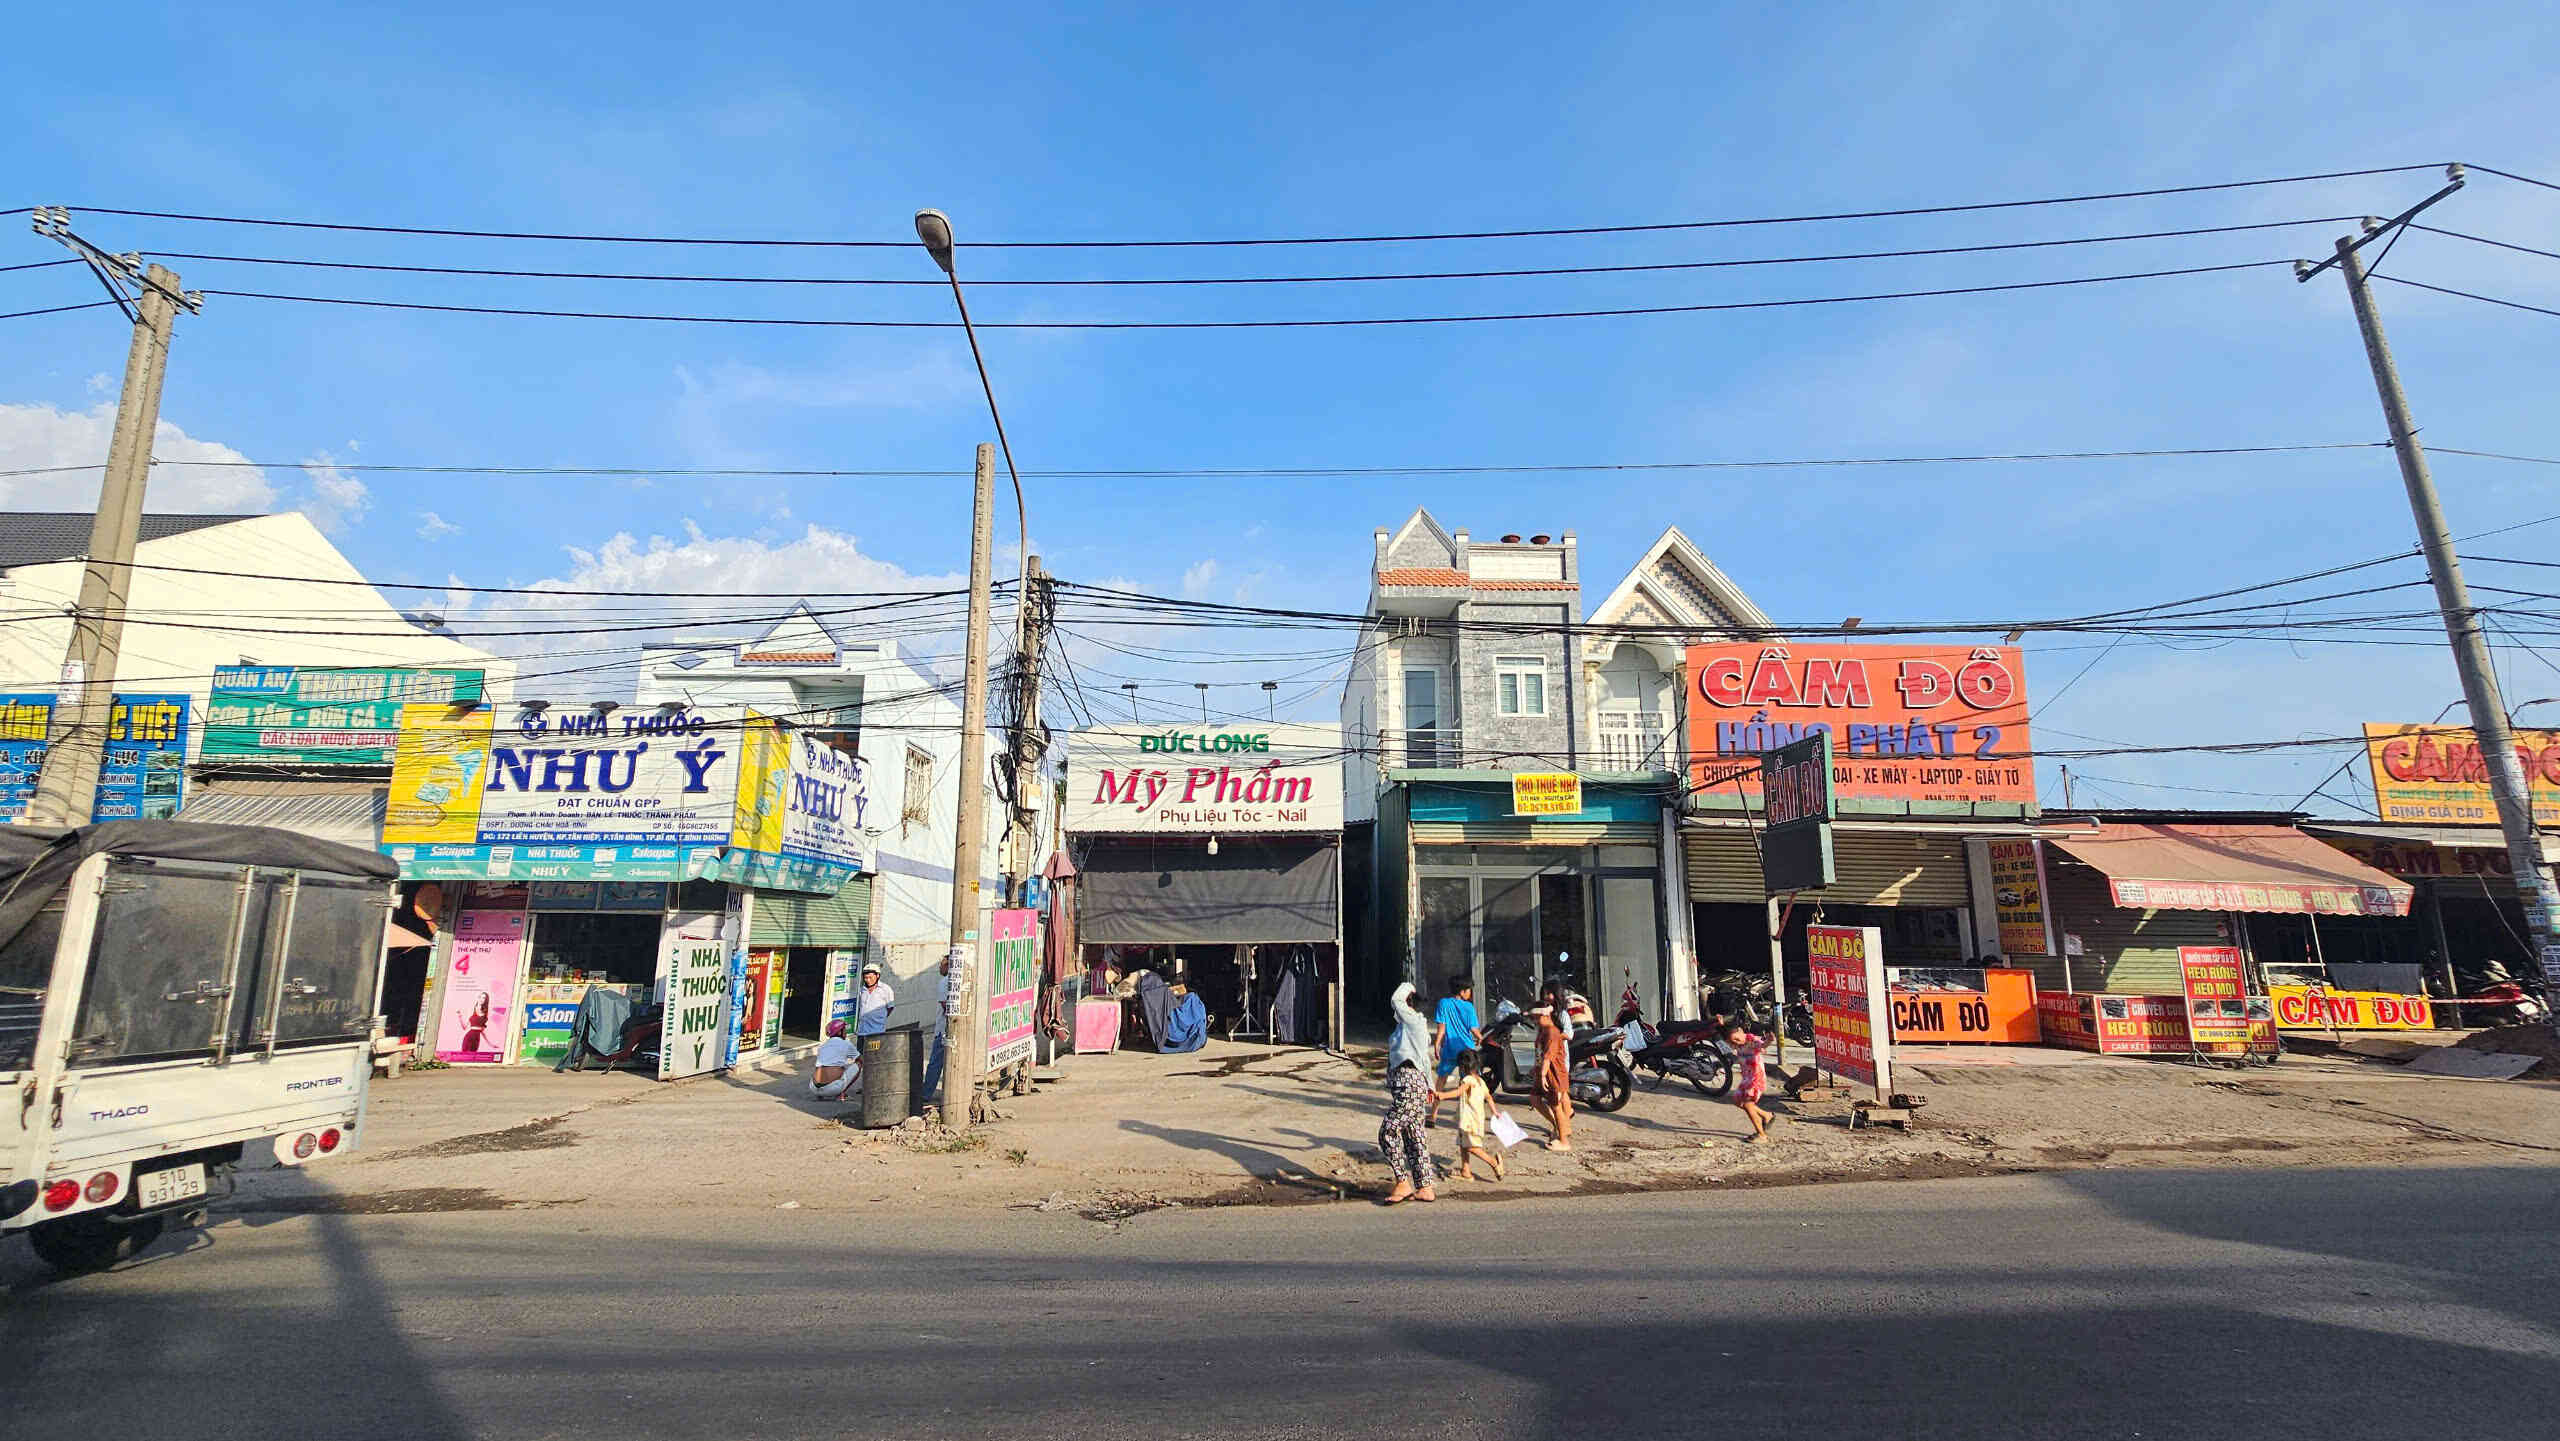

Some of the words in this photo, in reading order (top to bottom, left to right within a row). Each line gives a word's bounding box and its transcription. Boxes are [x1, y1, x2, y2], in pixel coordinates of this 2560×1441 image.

[1702, 646, 1873, 708] CẦM
[1896, 646, 2014, 709] ĐỒ
[622, 708, 705, 738] THUỐC
[1140, 729, 1195, 753] ĐỨC
[1198, 733, 1270, 753] LONG
[1846, 717, 1959, 760] PHÁT
[1972, 725, 2002, 761] 2
[486, 741, 649, 794] NHƯ
[674, 737, 726, 794] Ý
[1864, 768, 1879, 785] XE
[1882, 766, 1908, 785] MÁY
[1920, 768, 1964, 786] LAPTOP
[1975, 763, 2001, 786] GIẤY
[1092, 767, 1169, 813] Mỹ
[1178, 758, 1314, 804] Phẩm
[1516, 777, 1534, 793] CHO
[1536, 775, 1558, 793] THUÊ
[1560, 775, 1578, 792] NHÀ
[557, 798, 582, 810] ĐẠT
[635, 799, 661, 808] GPP
[789, 771, 847, 823] NHƯ
[851, 785, 869, 830] Ý
[1160, 809, 1190, 826] Phụ
[1195, 809, 1227, 826] Liệu
[1232, 808, 1262, 823] Tóc
[1278, 808, 1307, 823] Nail
[2456, 806, 2484, 819] CAO
[690, 943, 721, 968] NHÀ
[1809, 930, 1838, 957] CẦM
[1841, 928, 1865, 960] ĐỒ
[455, 954, 470, 976] 4
[2187, 966, 2208, 980] HEO
[681, 968, 727, 997] THUỐC
[1835, 973, 1846, 991] XE
[1848, 972, 1867, 994] MÁY
[2193, 982, 2214, 995] HEO
[531, 1007, 575, 1023] Salon
[681, 1000, 721, 1035] NHƯ
[1893, 993, 1944, 1031] CẦM
[2107, 1021, 2137, 1036] HEO
[693, 1035, 705, 1070] Ý
[286, 1076, 343, 1092] FRONTIER
[90, 1104, 149, 1122] THACO
